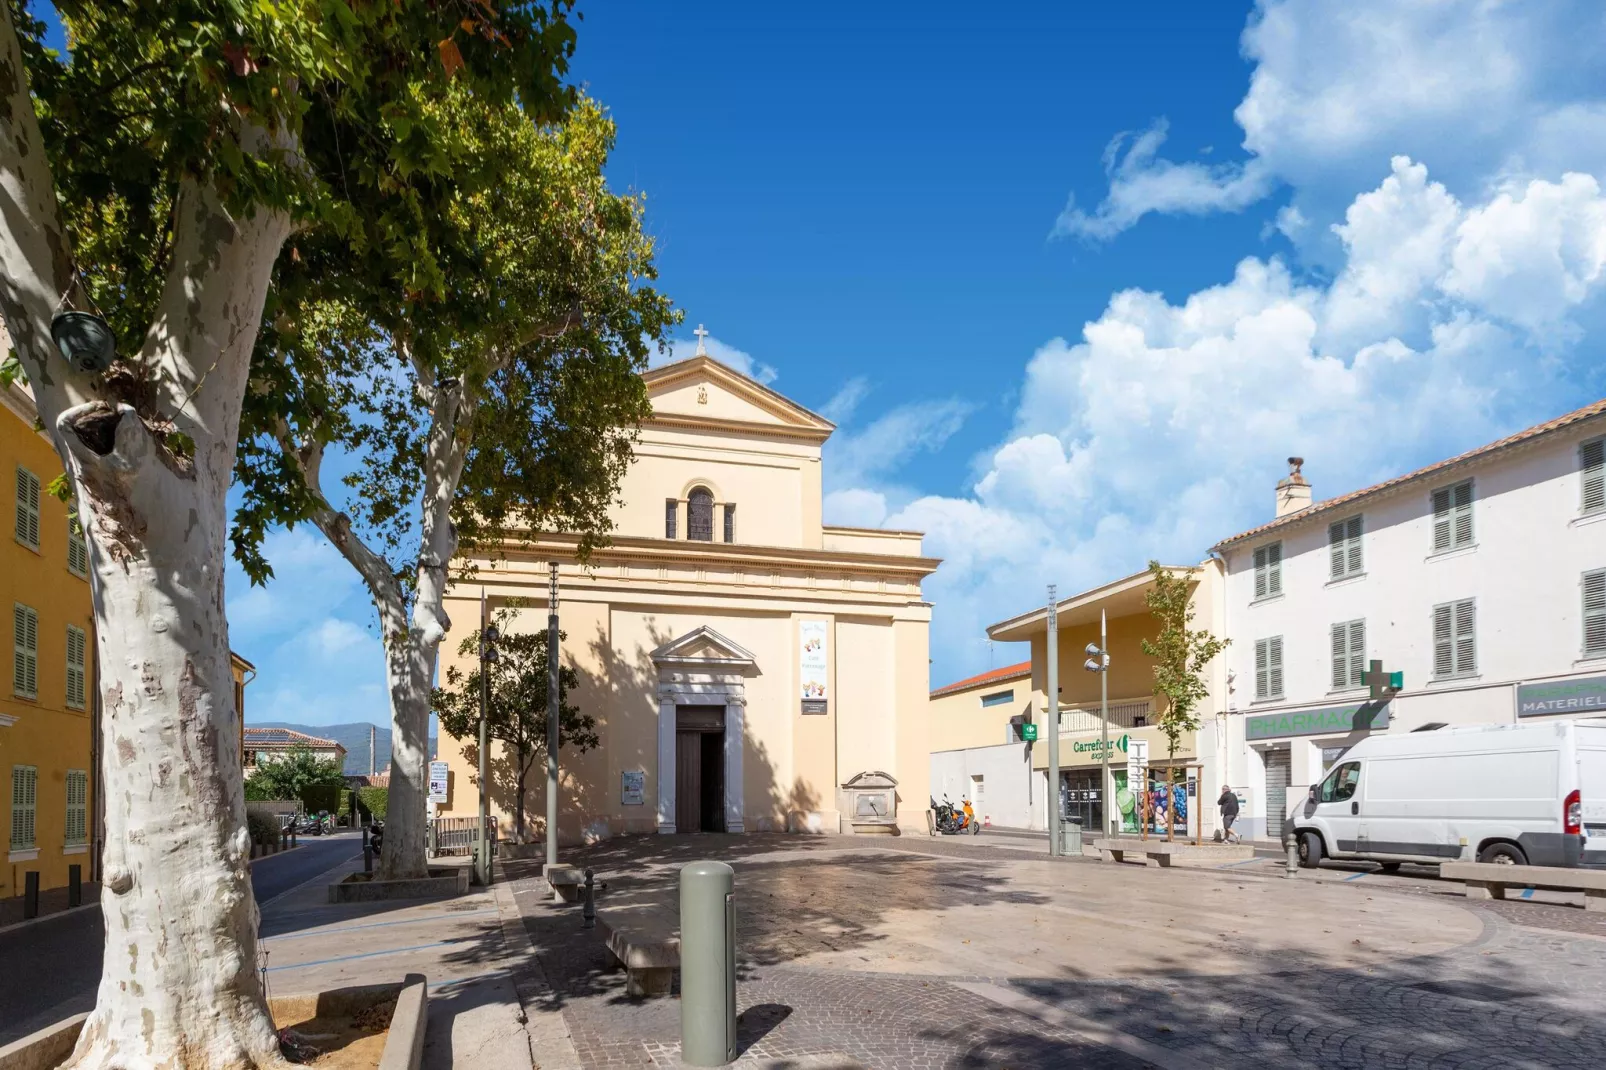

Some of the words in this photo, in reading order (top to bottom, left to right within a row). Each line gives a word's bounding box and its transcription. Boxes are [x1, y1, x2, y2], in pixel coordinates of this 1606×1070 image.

[1523, 696, 1606, 711] MATERIEL
[1249, 707, 1383, 736] PHARMACIE
[1091, 751, 1114, 763] expss
